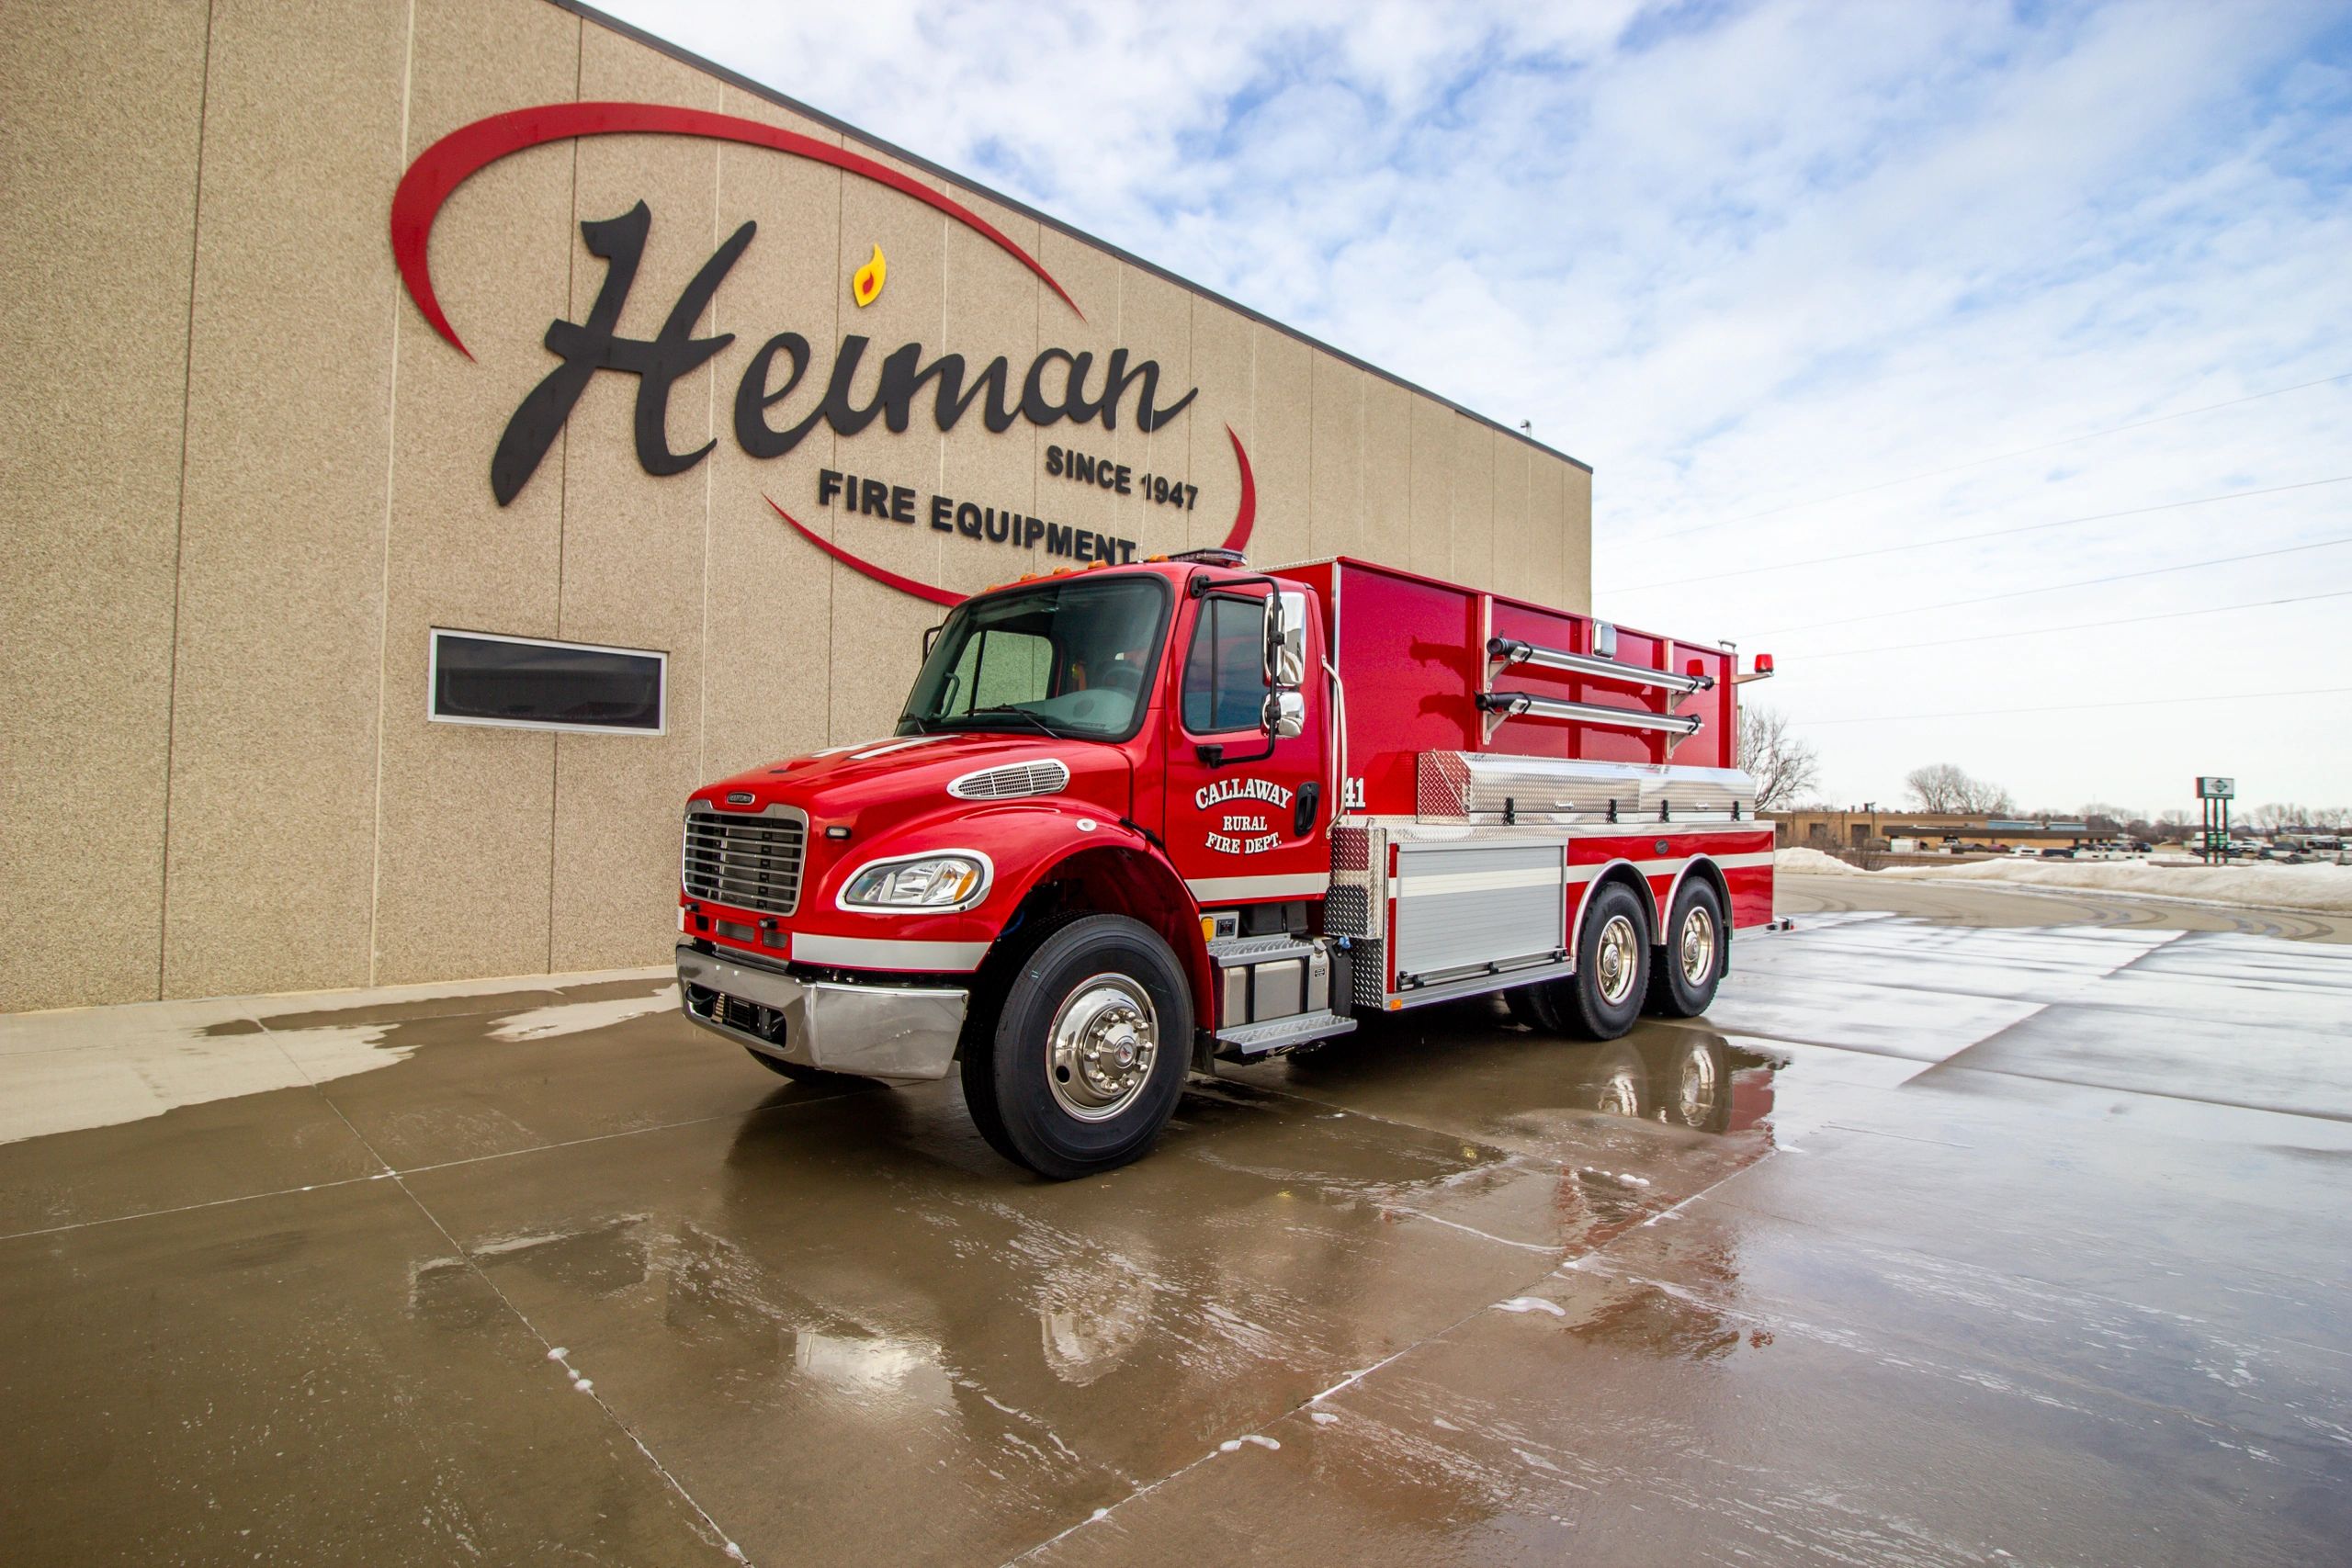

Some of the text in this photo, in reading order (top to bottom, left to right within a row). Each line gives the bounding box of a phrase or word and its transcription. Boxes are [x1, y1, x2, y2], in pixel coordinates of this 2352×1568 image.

[492, 199, 1198, 506] Heiman
[1046, 445, 1198, 511] SINCE 1947
[819, 468, 1136, 566] FIRE EQUIPMENT
[1195, 778, 1293, 809] CALLAWAY
[1205, 832, 1282, 853] FIRE DEPT.
[1223, 816, 1267, 830] RURAL
